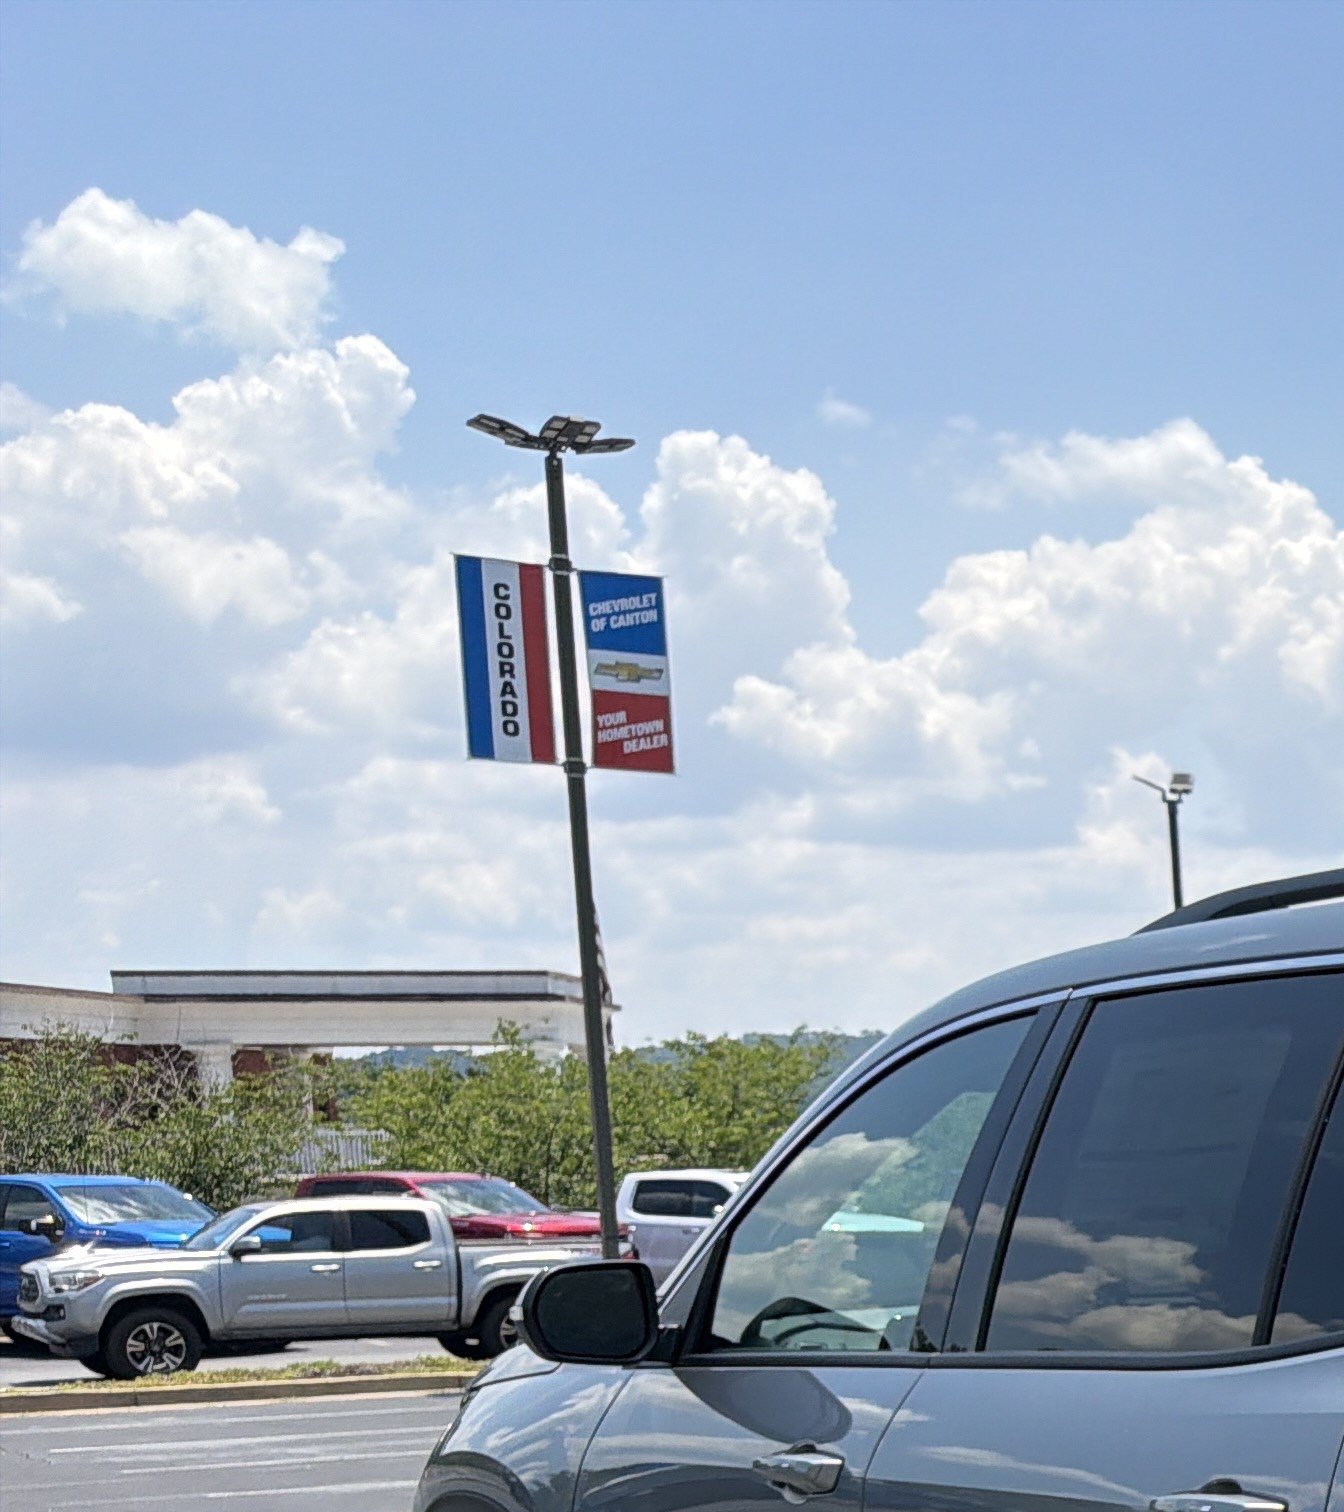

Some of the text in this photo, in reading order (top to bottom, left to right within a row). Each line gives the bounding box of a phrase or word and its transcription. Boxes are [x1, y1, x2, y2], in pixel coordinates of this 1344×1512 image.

[588, 592, 657, 617] CHEVROLET
[591, 608, 658, 633] OF CANTON
[493, 583, 520, 738] COLORADO
[596, 710, 627, 729] YOUR
[597, 718, 664, 744] HOMETOWN
[622, 733, 669, 755] DEALER
